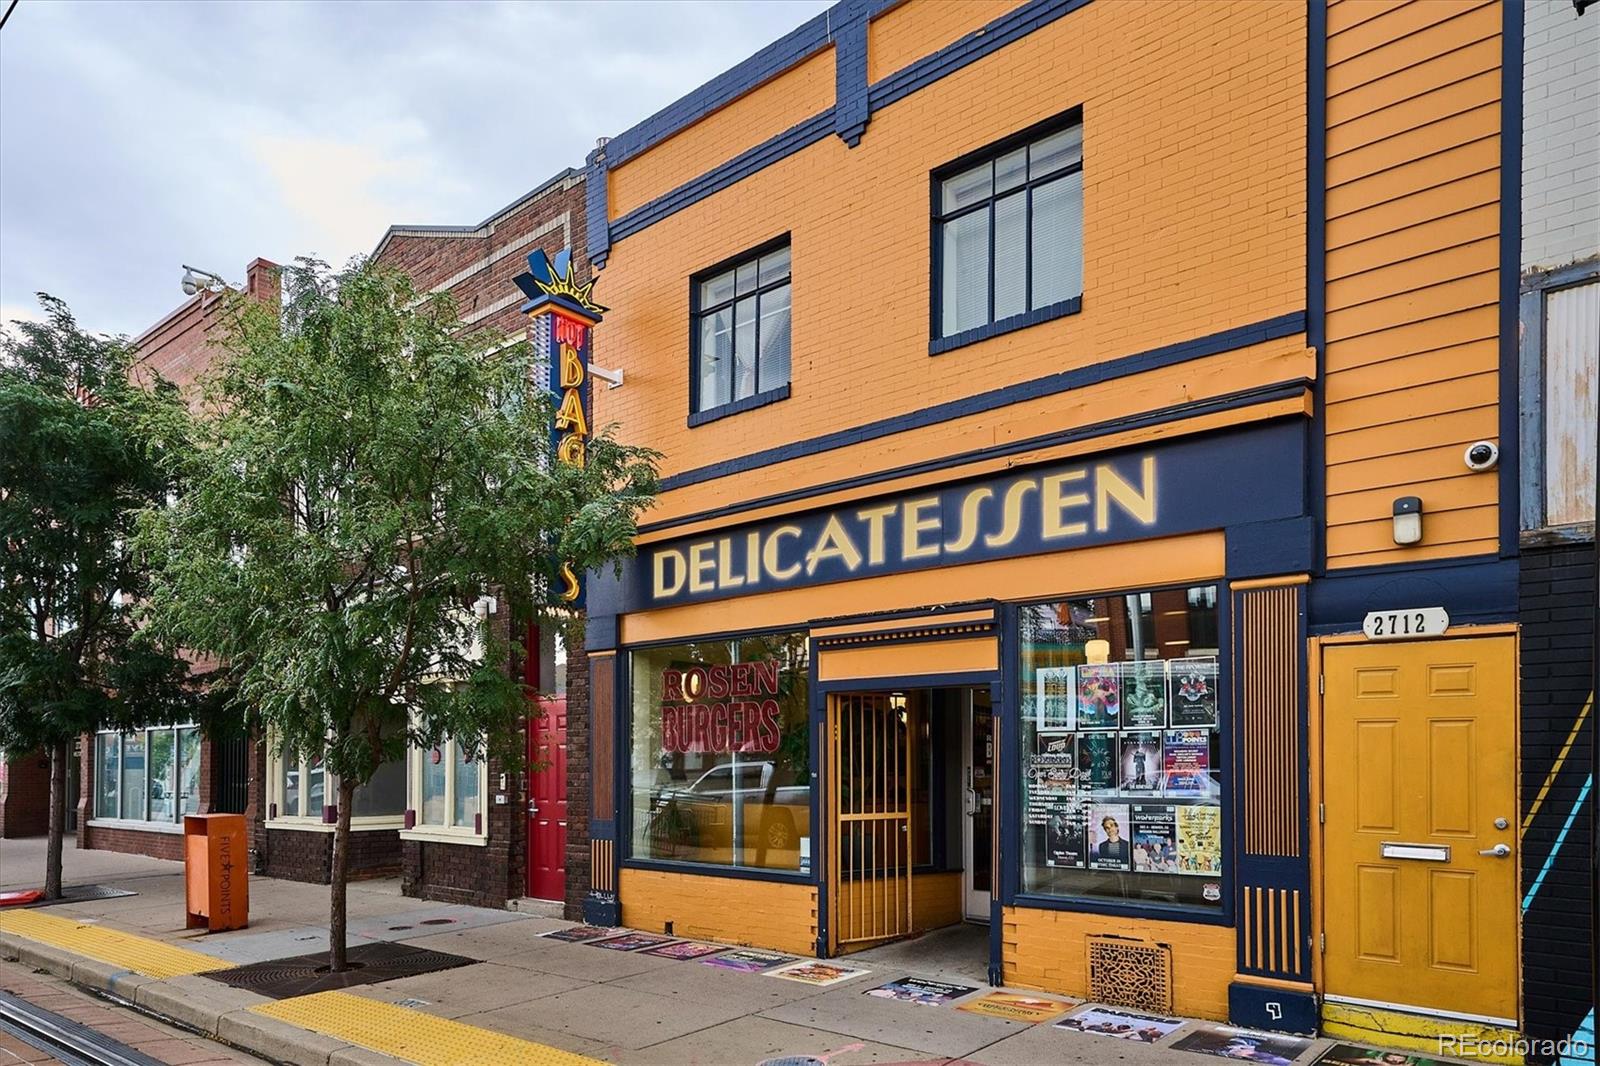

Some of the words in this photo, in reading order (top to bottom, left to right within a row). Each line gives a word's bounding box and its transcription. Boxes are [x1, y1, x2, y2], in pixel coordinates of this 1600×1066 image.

[652, 456, 1156, 599] DELICATESSEN
[1374, 613, 1425, 636] 2712
[661, 659, 781, 701] ROSEN
[661, 699, 781, 753] BURGERS
[1135, 814, 1173, 822] waterparks
[219, 835, 231, 862] FIVE
[219, 875, 232, 914] POINTS
